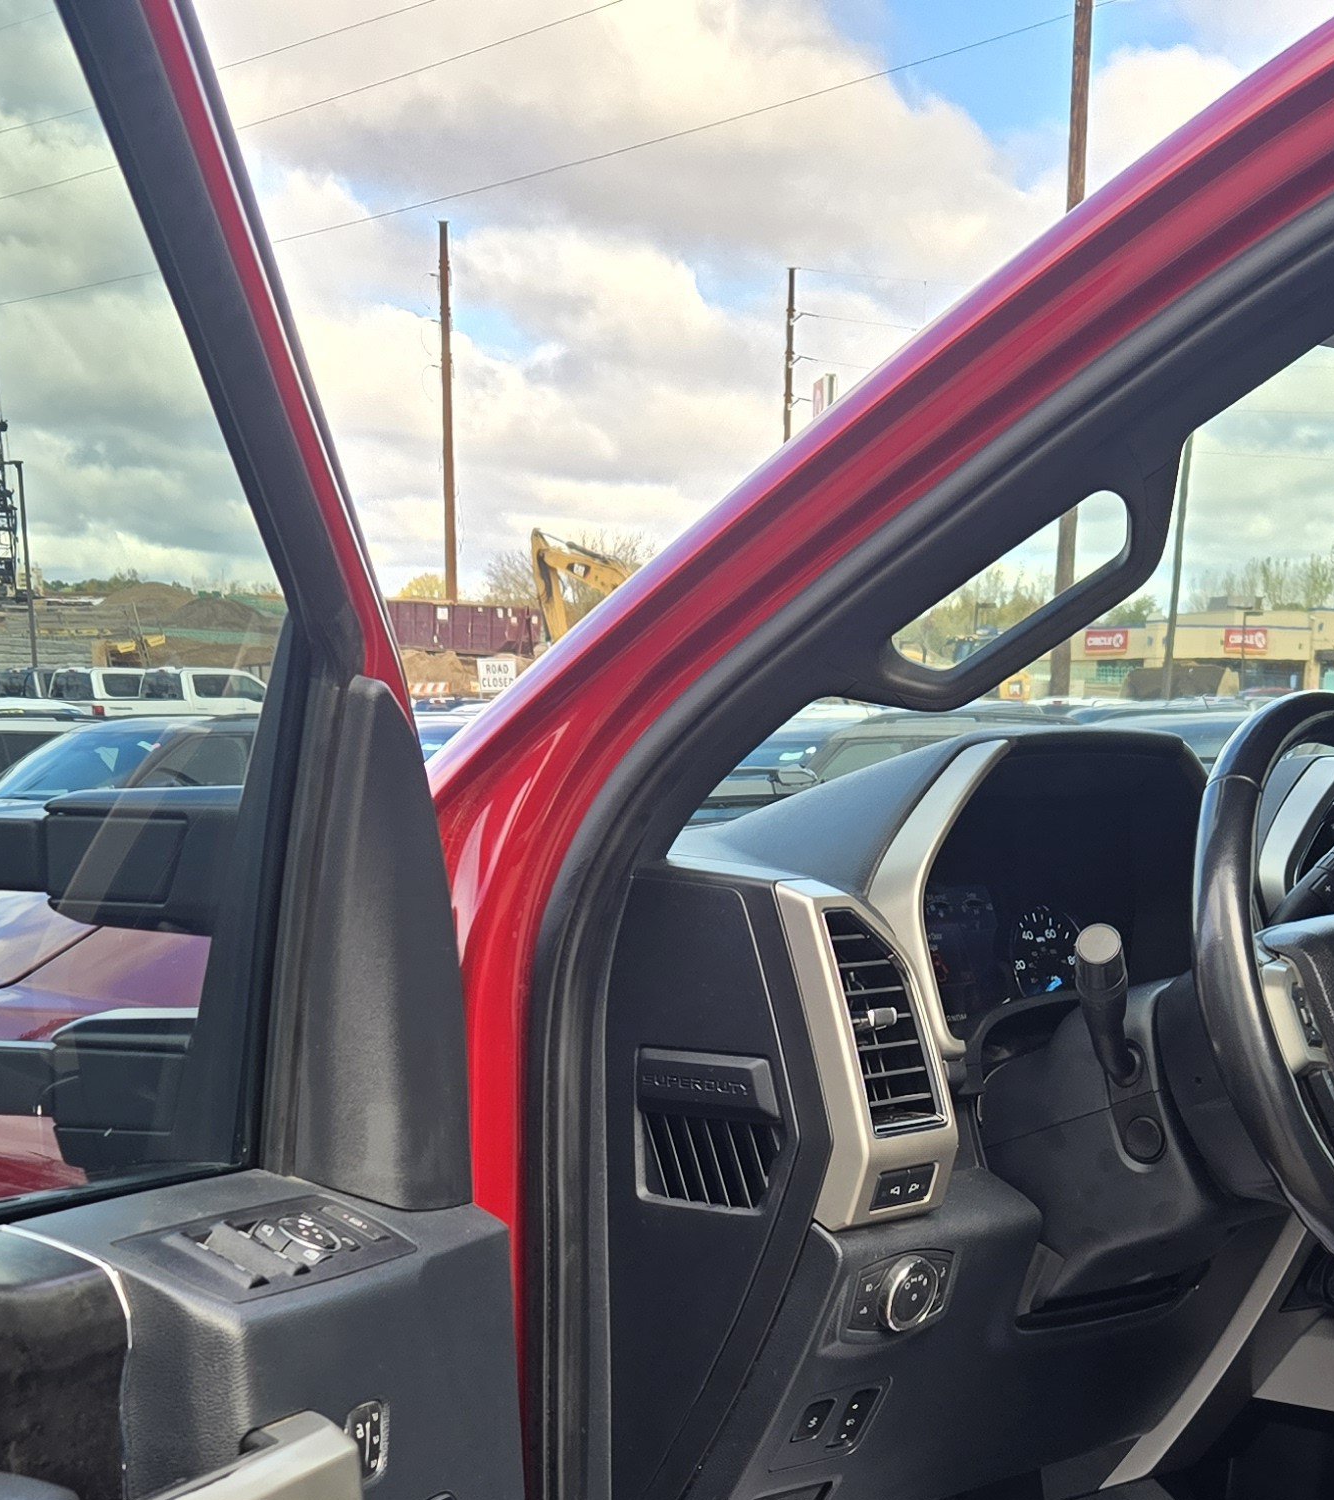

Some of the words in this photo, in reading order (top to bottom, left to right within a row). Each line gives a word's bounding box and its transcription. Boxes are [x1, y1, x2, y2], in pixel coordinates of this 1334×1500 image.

[485, 664, 509, 675] ROAD
[1022, 930, 1034, 940] 40
[1044, 929, 1057, 939] 60
